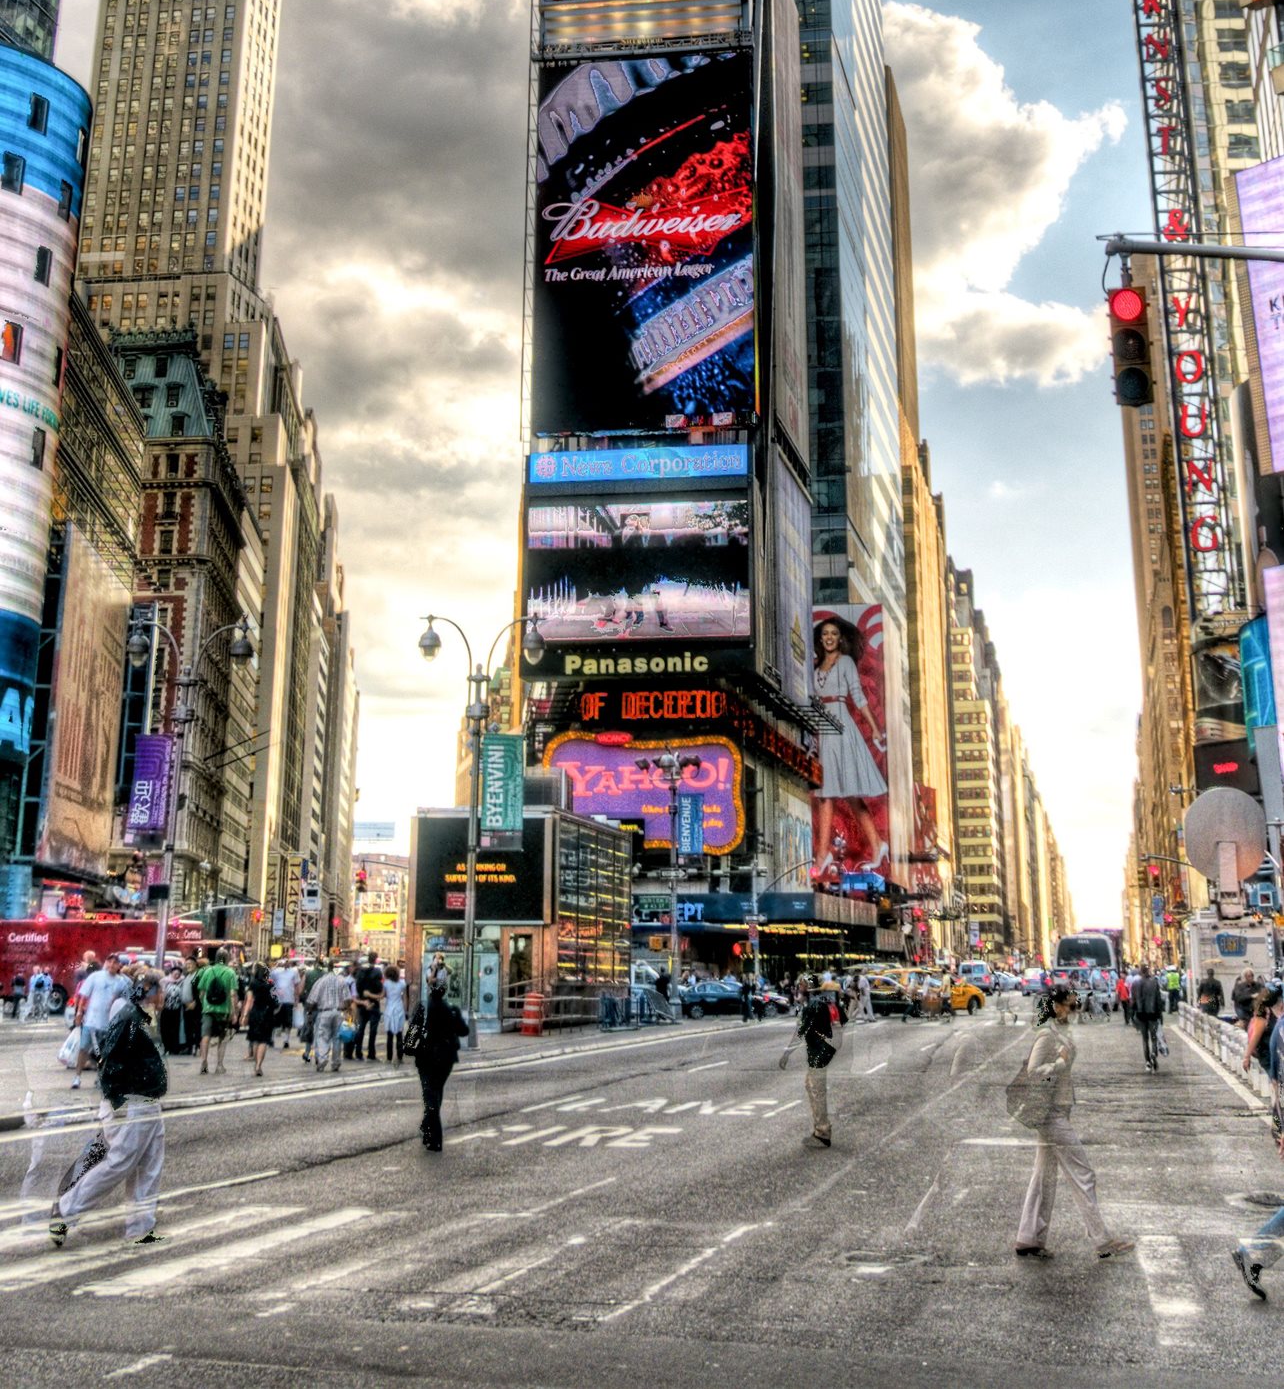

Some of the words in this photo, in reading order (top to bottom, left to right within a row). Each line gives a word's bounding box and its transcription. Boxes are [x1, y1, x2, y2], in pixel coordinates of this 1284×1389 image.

[541, 199, 742, 242] Budweiser
[545, 268, 569, 282] The
[570, 267, 606, 282] Great
[607, 263, 673, 281] American
[1172, 293, 1219, 553] YOUNG
[561, 456, 613, 477] News
[621, 450, 742, 477] Corporation
[565, 652, 709, 676] Panasonic
[580, 692, 608, 721] OF
[486, 744, 505, 827] BYENVINI
[681, 796, 692, 852] BIENVENUE
[8, 932, 49, 943] Certified
